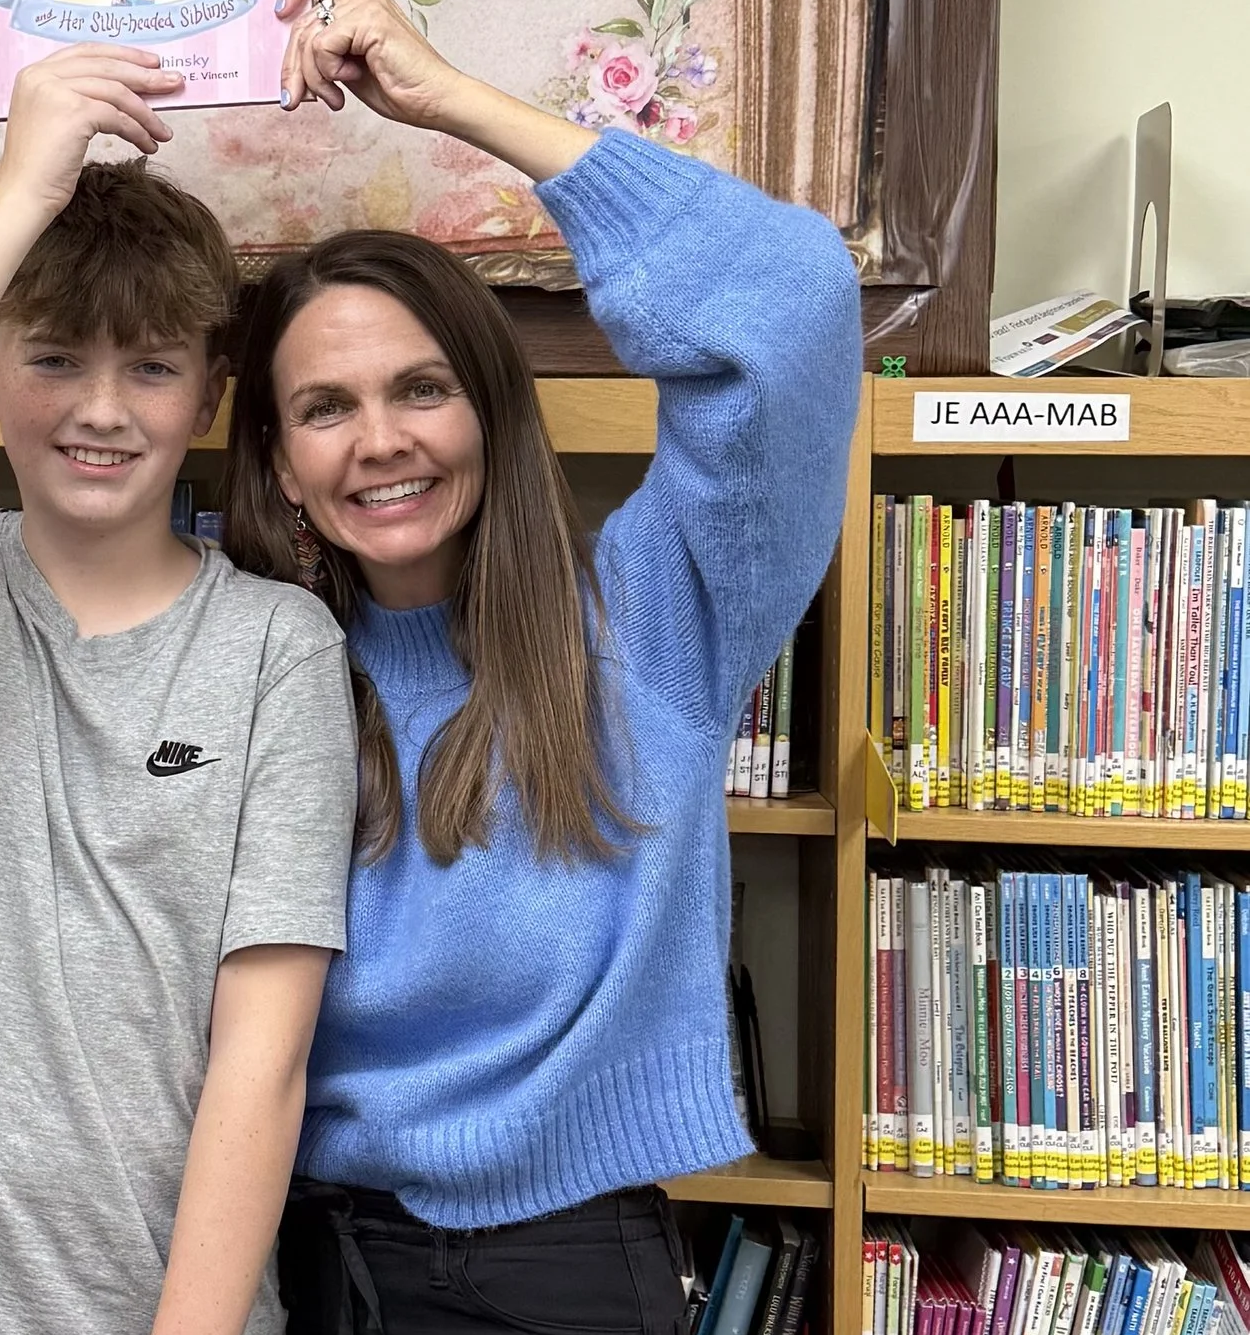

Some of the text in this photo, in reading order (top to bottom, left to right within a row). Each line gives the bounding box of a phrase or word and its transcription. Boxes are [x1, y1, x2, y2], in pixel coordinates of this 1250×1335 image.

[35, 9, 56, 25] and
[59, 10, 84, 31] Her
[90, 10, 175, 37] Silly-headed
[201, 70, 239, 80] Vincent
[931, 402, 1118, 426] JE AAA-MAB
[942, 514, 951, 549] ARNOLD
[1040, 514, 1049, 550] ARNOLD
[1002, 599, 1013, 638] PRINCE
[1189, 636, 1198, 664] Than
[154, 739, 204, 766] NIKE
[1107, 911, 1115, 934] WHO
[1107, 934, 1116, 952] PUT
[1004, 969, 1013, 979] 2
[1031, 969, 1040, 979] 4
[1045, 970, 1052, 980] 5
[1053, 966, 1061, 977] 6
[1079, 969, 1088, 979] 8
